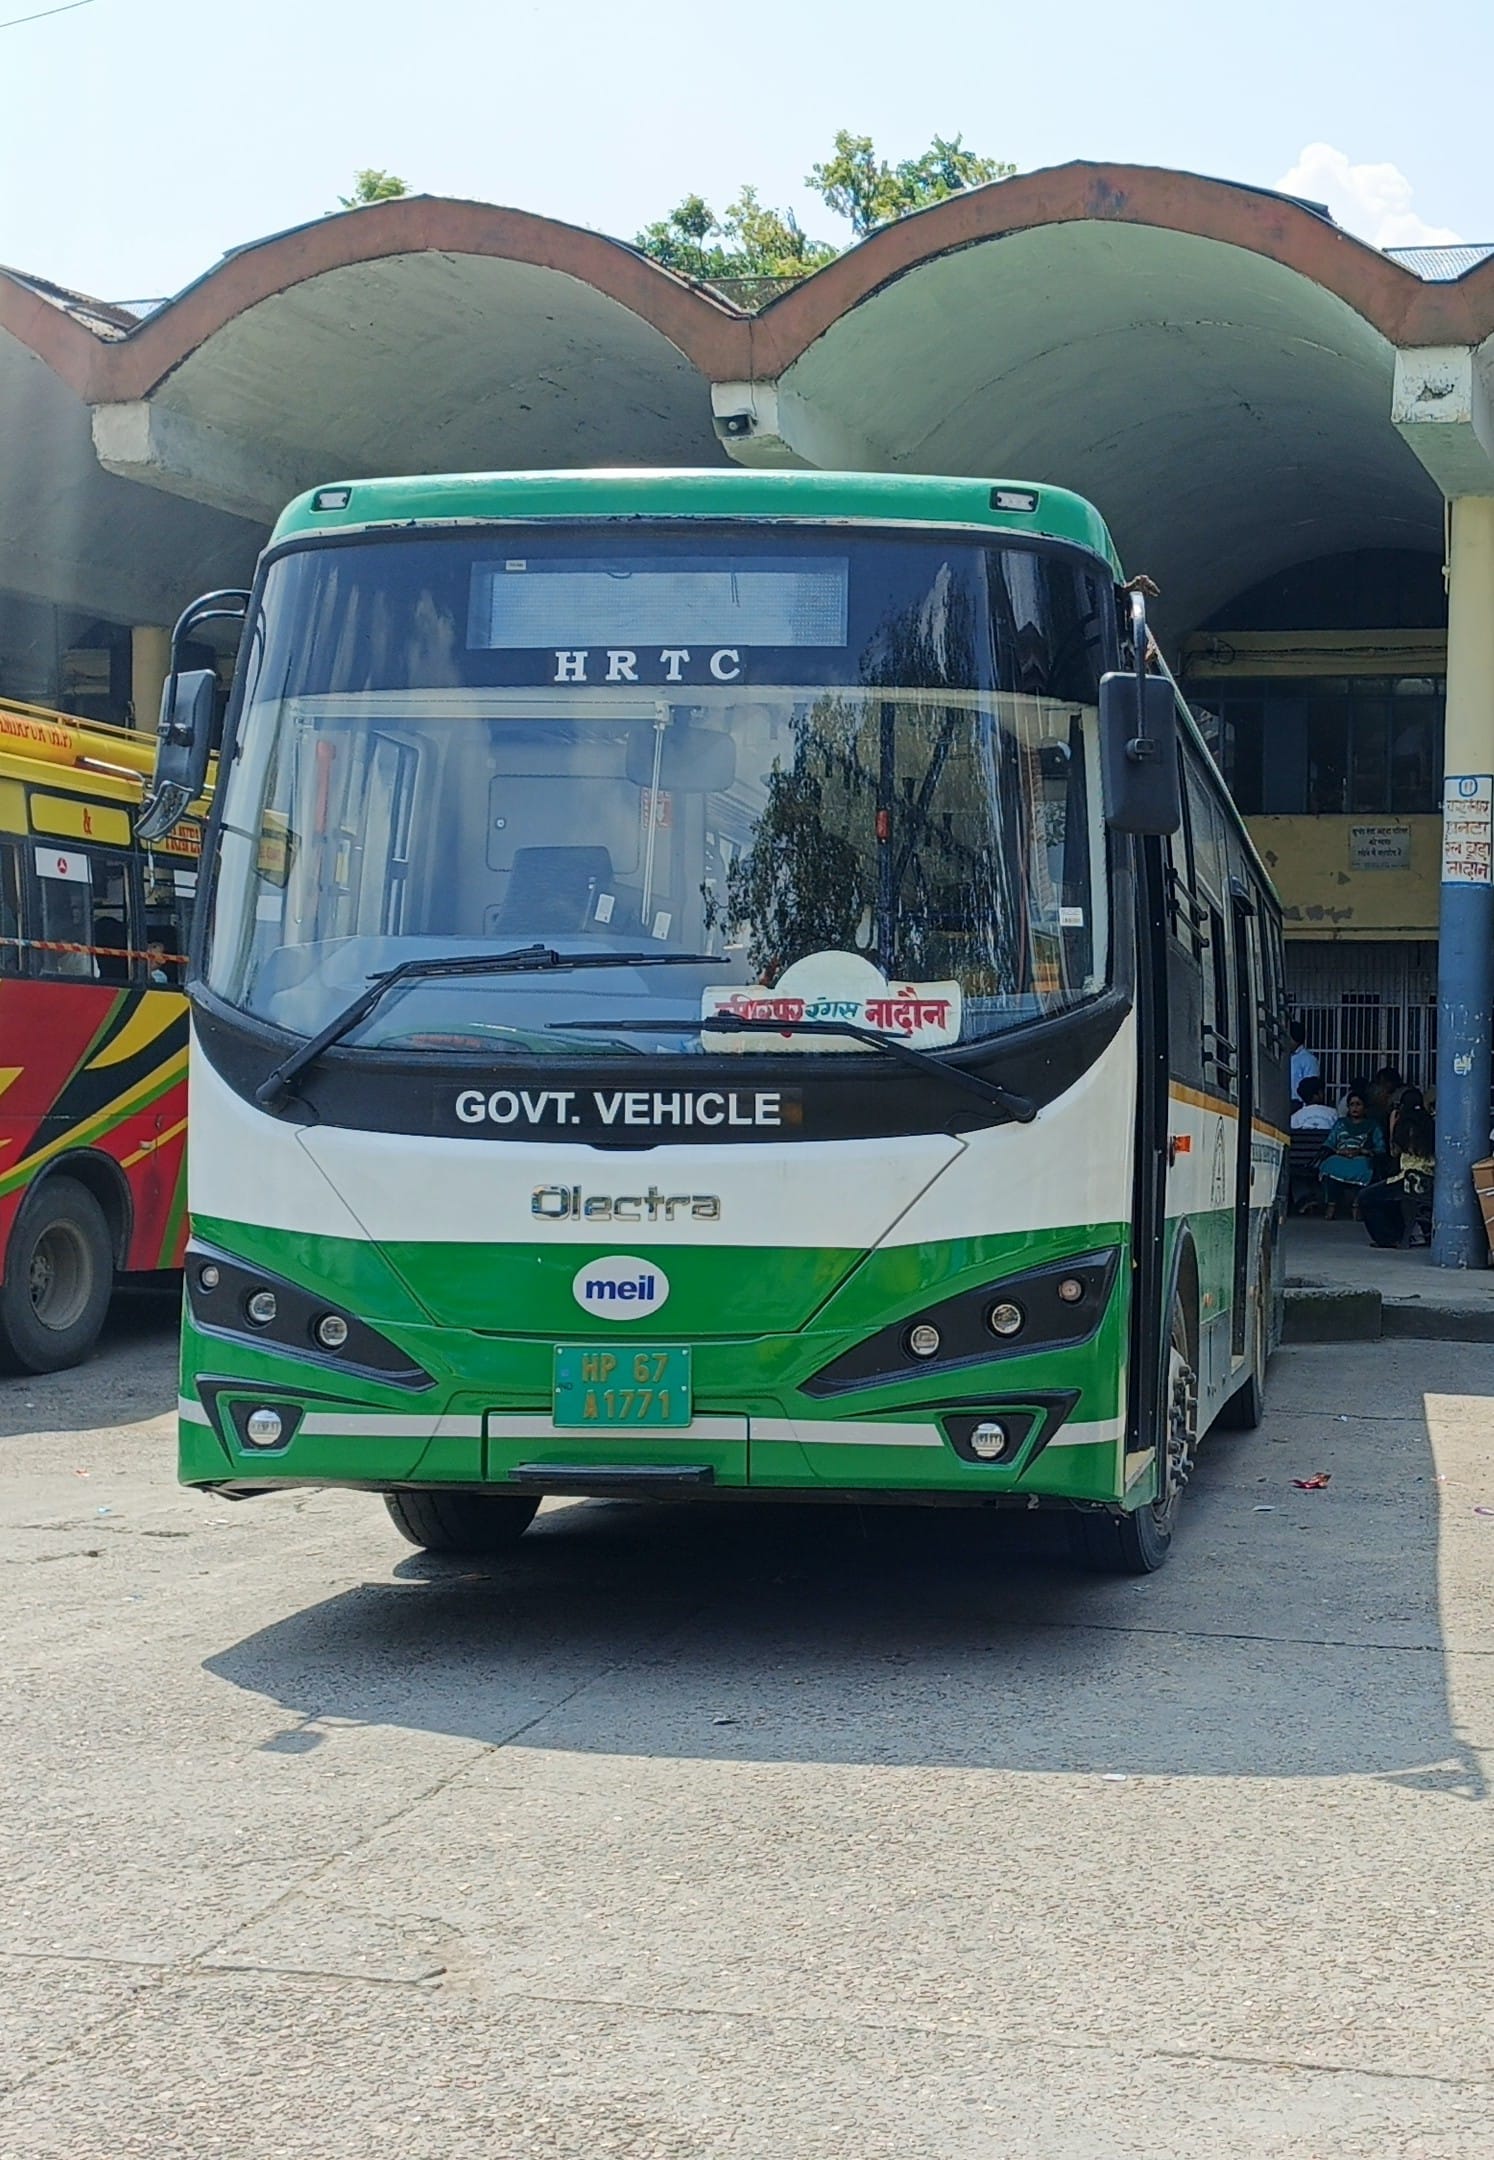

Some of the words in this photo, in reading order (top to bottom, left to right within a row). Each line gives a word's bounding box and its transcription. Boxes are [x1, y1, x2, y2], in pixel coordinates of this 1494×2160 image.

[865, 986, 953, 1037] नादौन
[455, 1090, 581, 1124] GOVT.
[593, 1091, 782, 1126] VEHICLE
[531, 1184, 721, 1222] Olectra
[585, 1275, 655, 1301] meil
[582, 1352, 616, 1383] HP
[634, 1352, 669, 1383] 67
[583, 1389, 671, 1420] A1771
